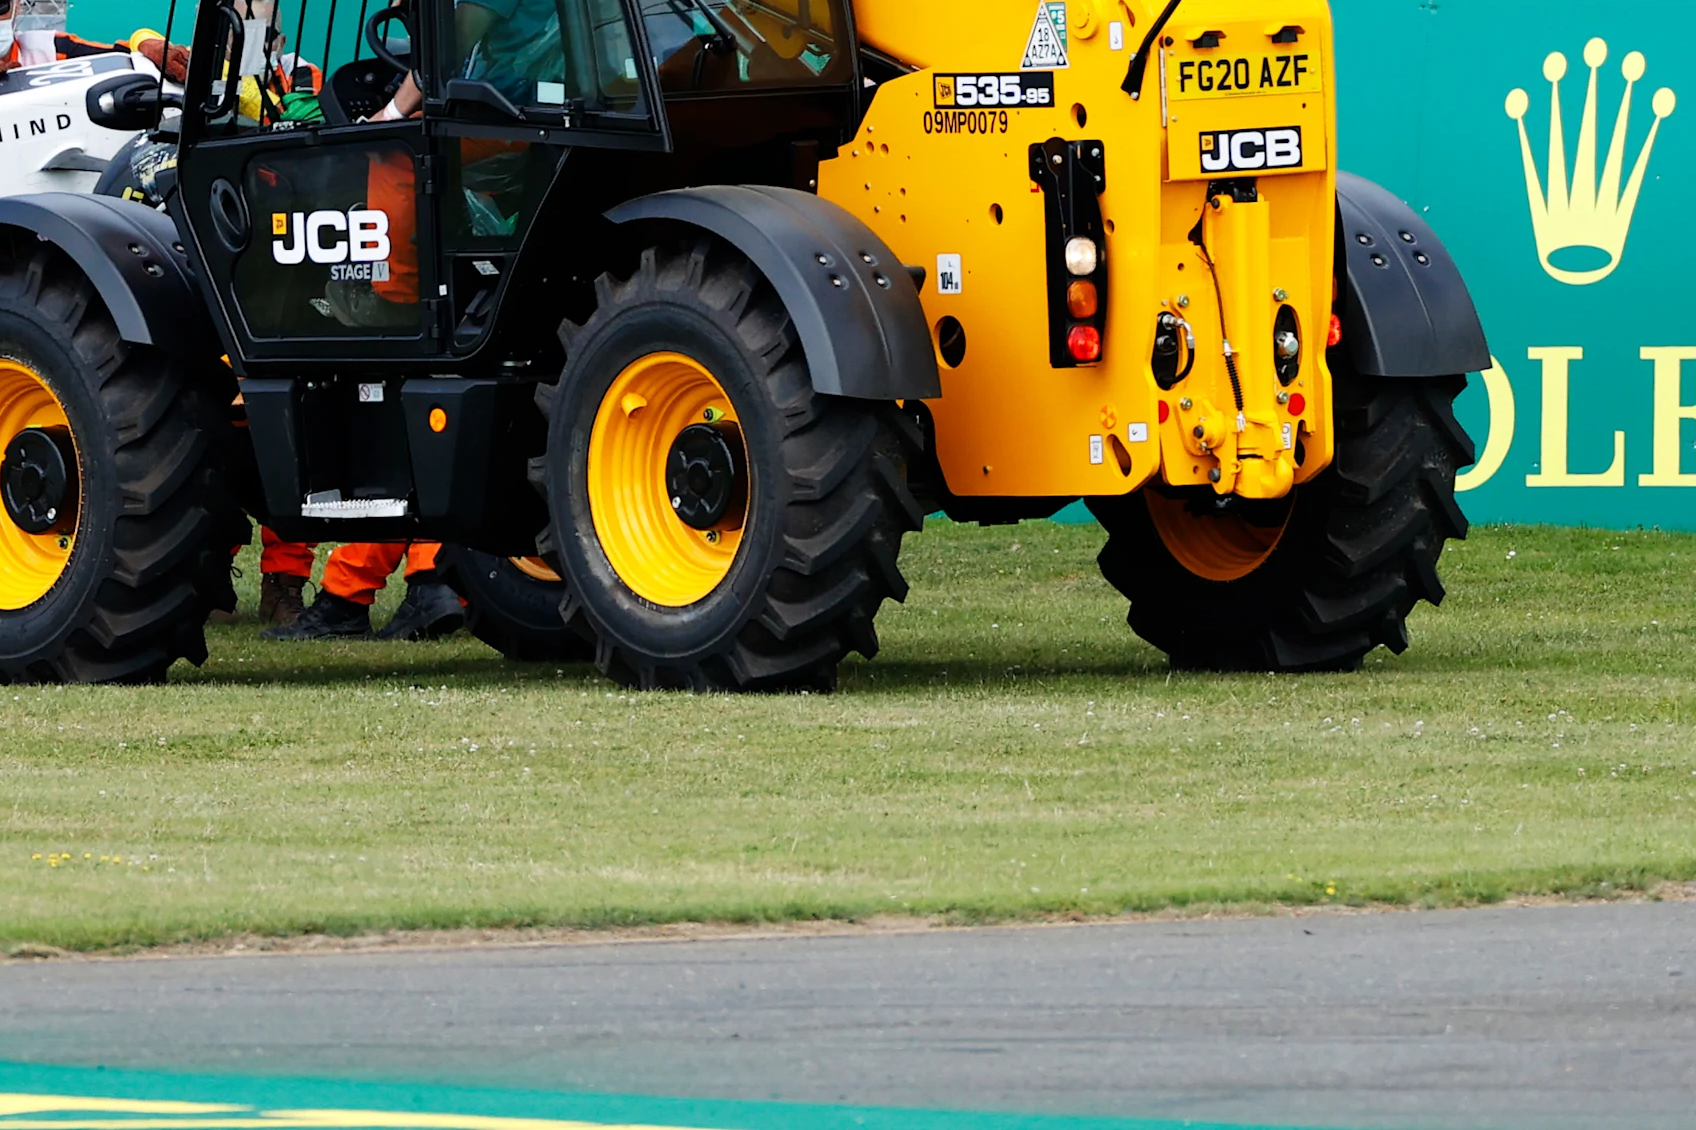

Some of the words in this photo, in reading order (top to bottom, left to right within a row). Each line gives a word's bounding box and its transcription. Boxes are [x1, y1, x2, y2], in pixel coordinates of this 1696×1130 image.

[1179, 58, 1250, 92] FG20
[1259, 54, 1309, 88] AZF
[923, 110, 1008, 134] 09MP0079
[1201, 129, 1301, 171] JCB
[272, 209, 392, 265] JCB
[331, 263, 371, 281] STAGE
